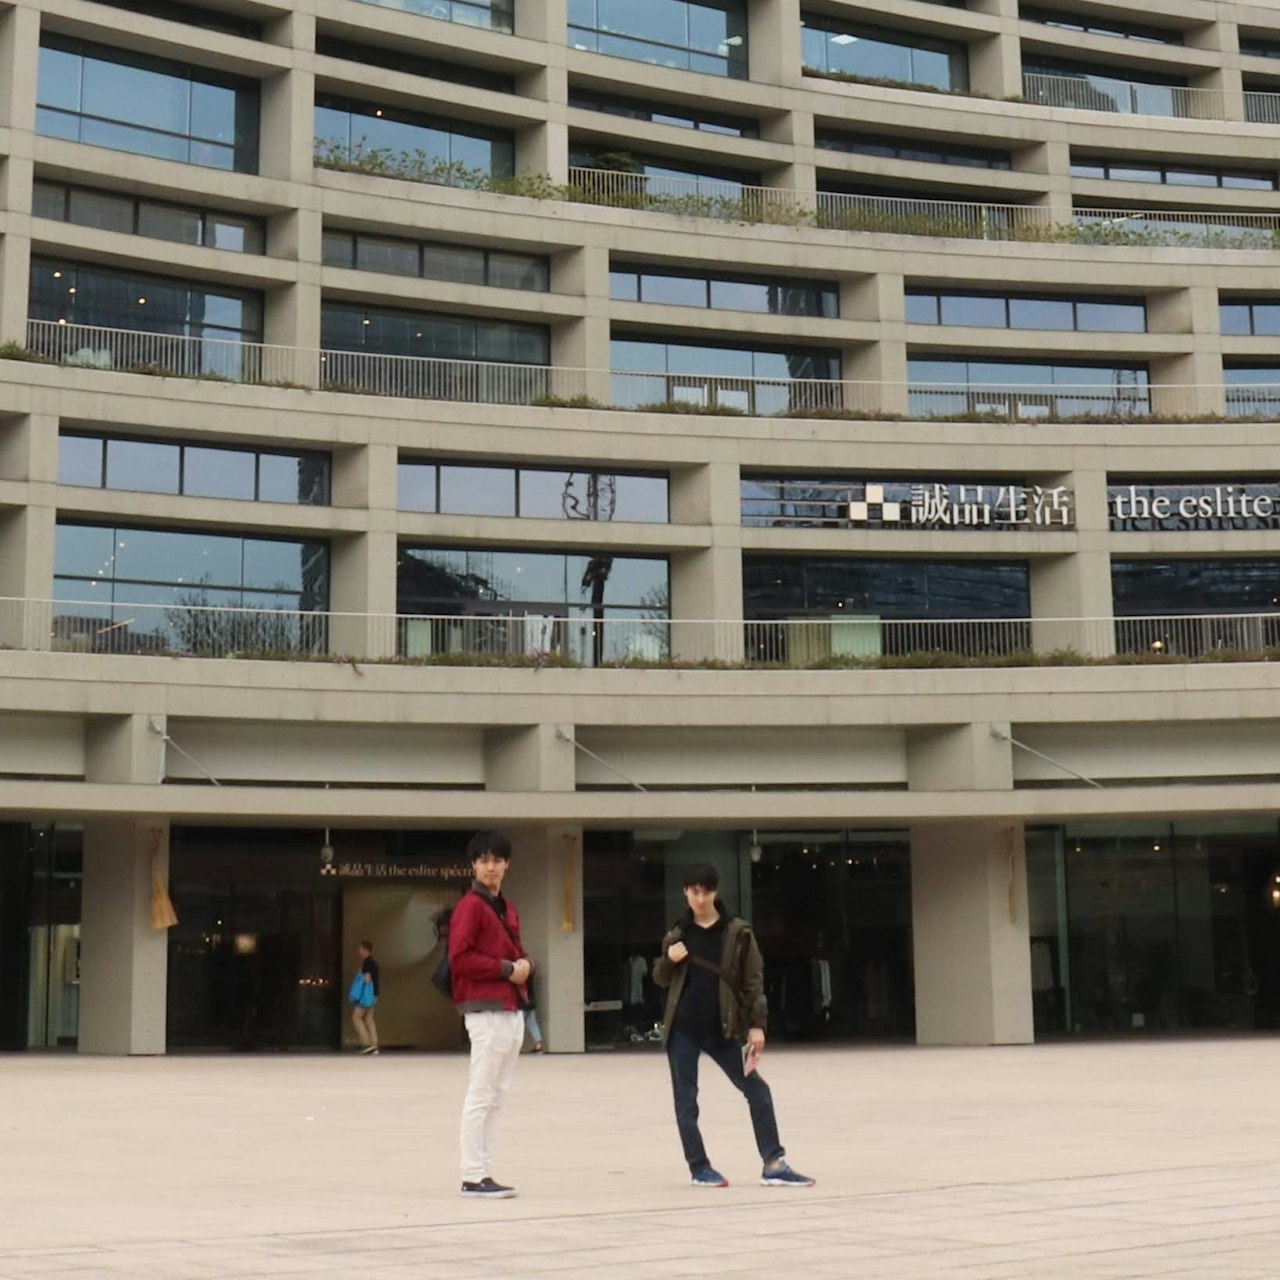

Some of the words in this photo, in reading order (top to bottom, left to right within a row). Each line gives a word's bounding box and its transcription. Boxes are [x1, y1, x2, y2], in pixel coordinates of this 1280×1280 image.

[910, 483, 1070, 525] 誠品生活
[1114, 485, 1169, 519] the
[1179, 485, 1272, 520] eslite
[389, 864, 407, 876] the
[408, 863, 438, 876] eslite
[439, 866, 472, 880] spectr
